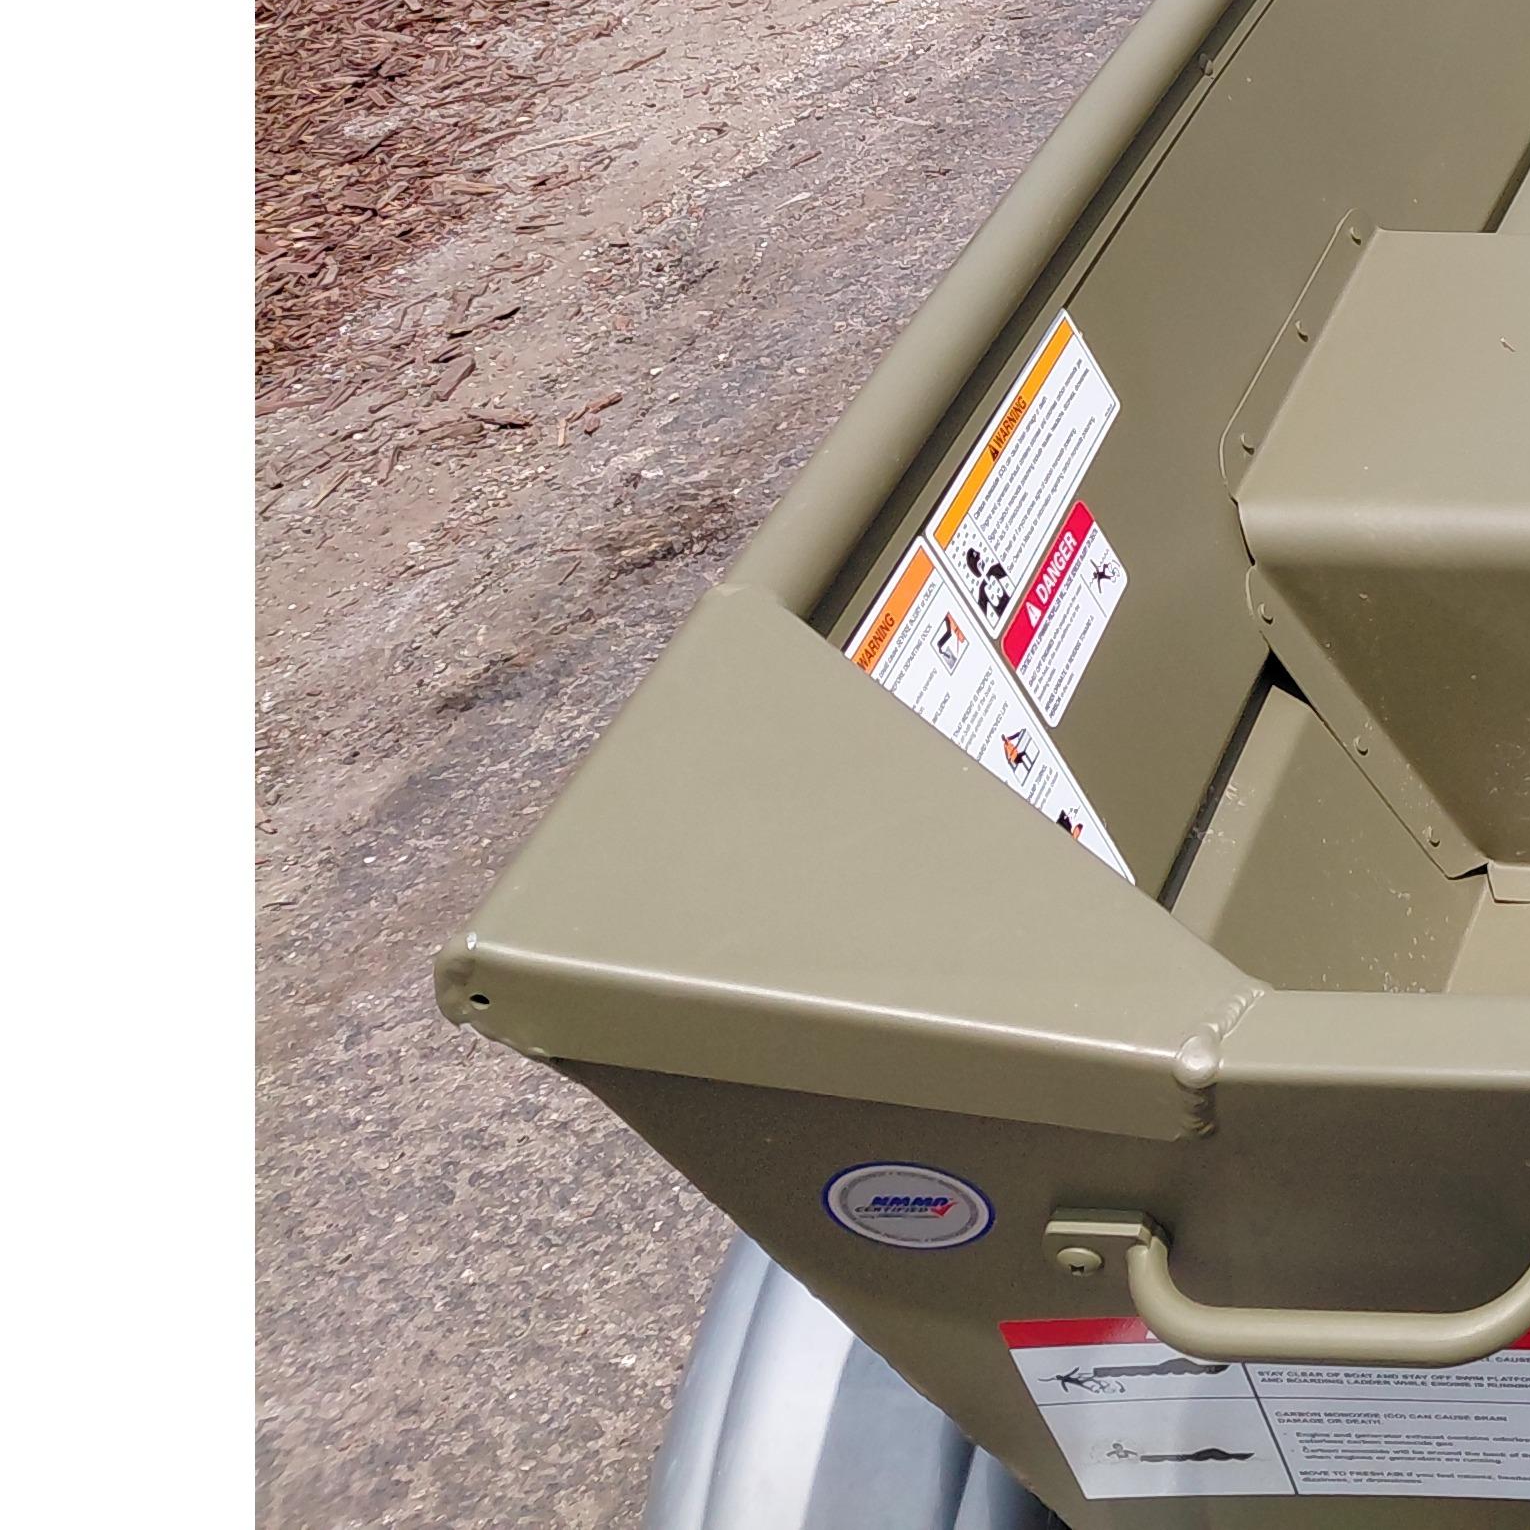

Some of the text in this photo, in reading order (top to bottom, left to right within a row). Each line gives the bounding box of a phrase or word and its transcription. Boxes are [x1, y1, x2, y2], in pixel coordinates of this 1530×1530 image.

[992, 393, 1027, 450] WARNING
[1033, 528, 1078, 605] DANGER
[856, 609, 895, 675] WARNING
[855, 1206, 930, 1214] CERTIFIED
